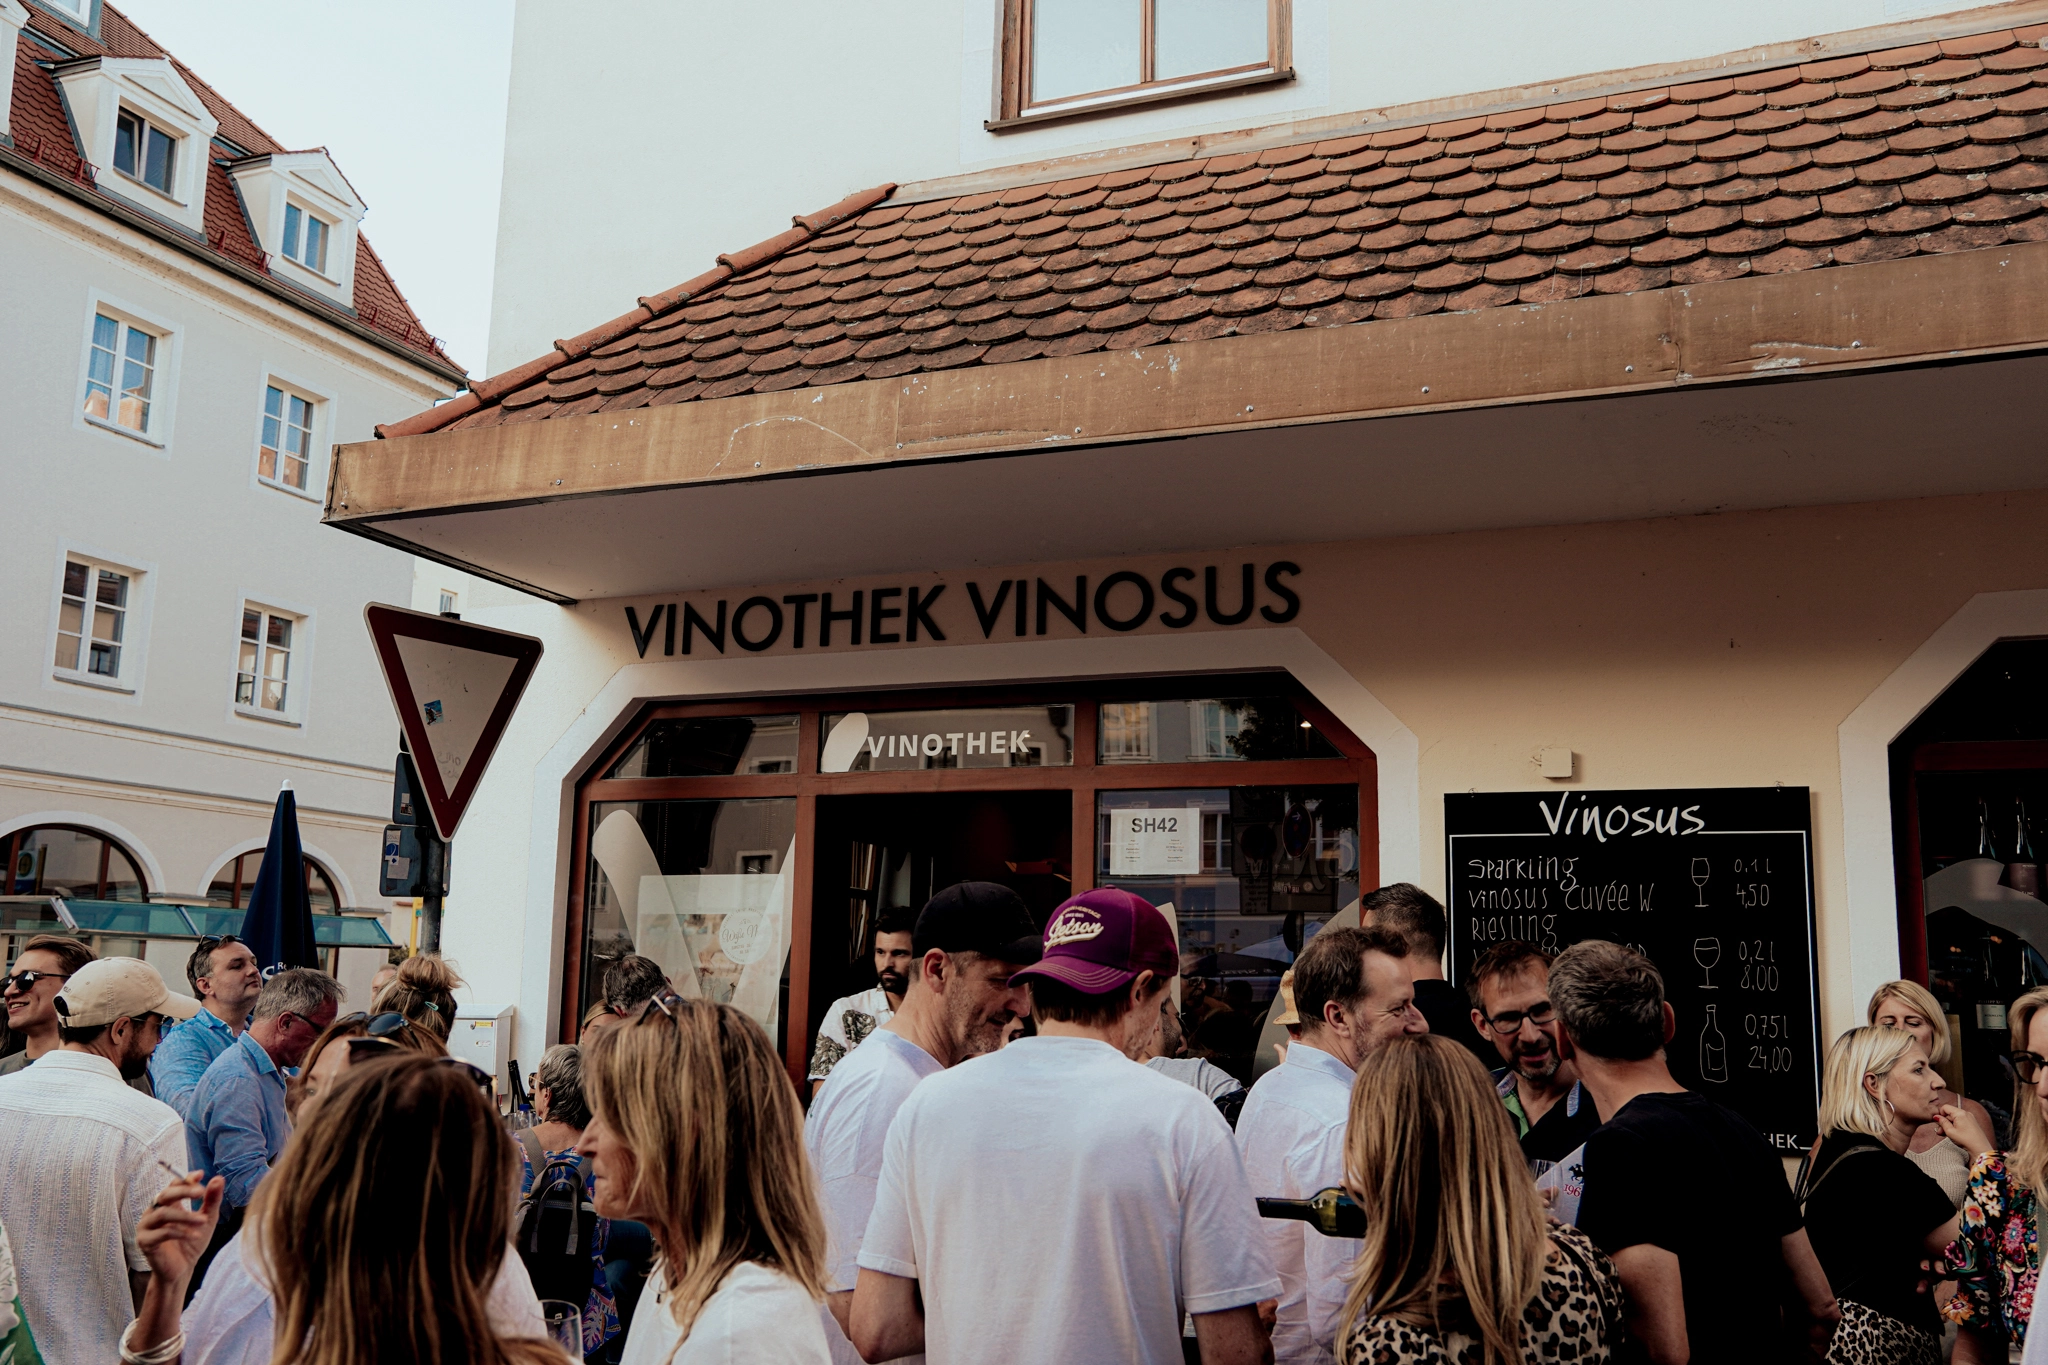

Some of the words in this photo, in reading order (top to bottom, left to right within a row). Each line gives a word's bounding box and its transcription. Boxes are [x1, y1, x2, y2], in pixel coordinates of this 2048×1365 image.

[625, 585, 946, 659] VINOTHEK
[967, 561, 1302, 639] VINOSUS
[867, 730, 1030, 758] VINOTHEK
[1131, 817, 1178, 833] SH42
[1539, 791, 1705, 842] Vinosus
[1736, 884, 1769, 908] 4,50
[1472, 914, 1557, 949] Riesling
[1748, 1046, 1792, 1073] 24,00
